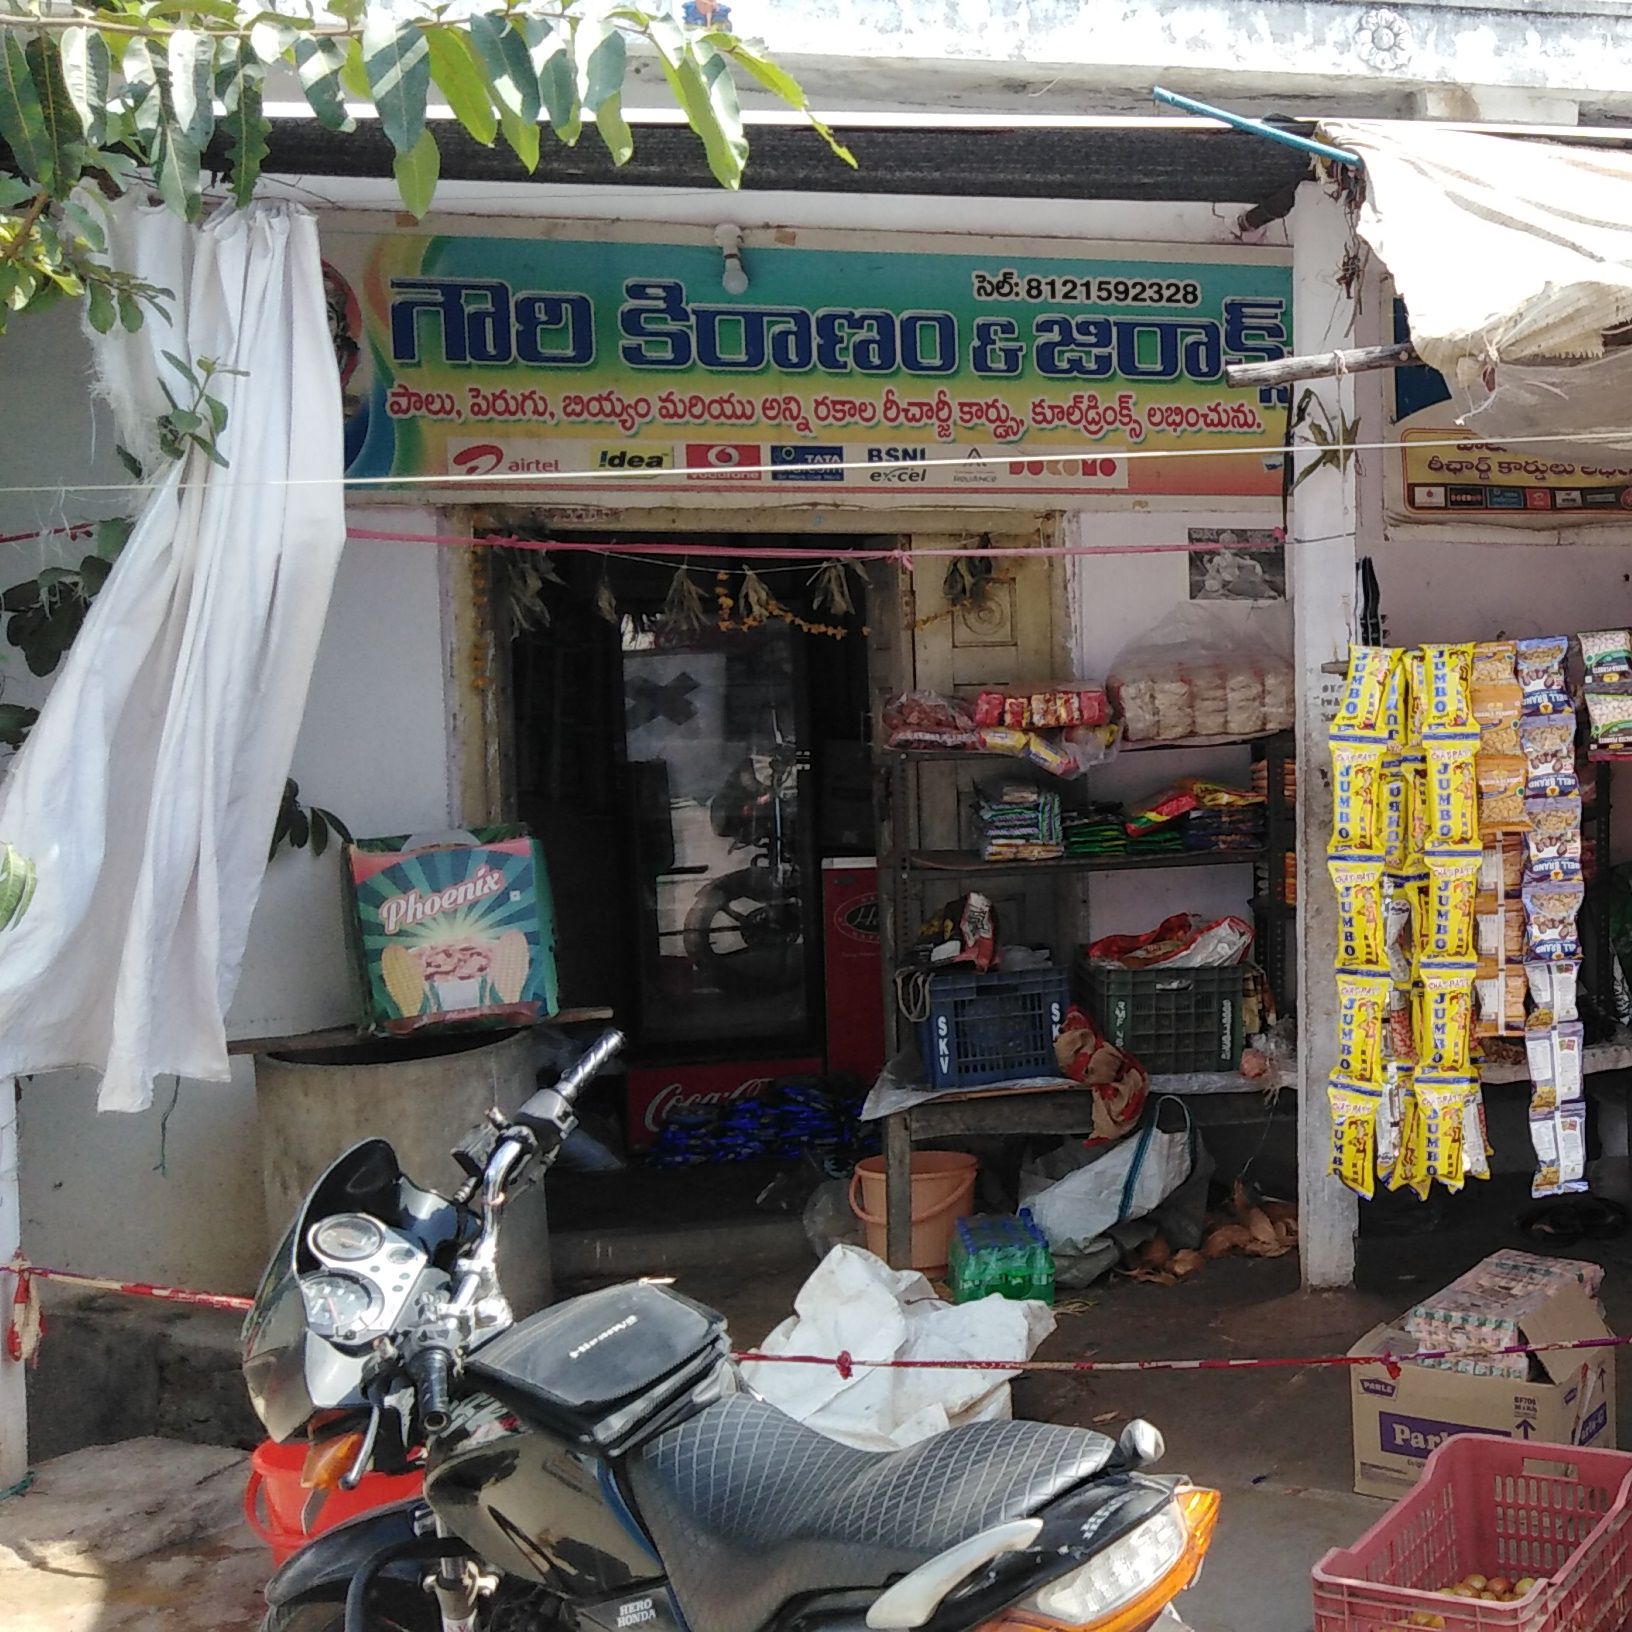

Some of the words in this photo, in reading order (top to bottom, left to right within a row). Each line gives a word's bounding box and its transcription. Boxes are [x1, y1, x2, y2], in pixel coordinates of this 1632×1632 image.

[1025, 278, 1199, 304] 8121592328
[390, 278, 594, 365] గౌరి
[619, 278, 958, 373] కిరాణం
[973, 317, 1023, 374] &
[389, 385, 462, 421] పాలు,
[469, 387, 555, 421] పెరుగు,
[562, 390, 651, 431] బియ్యం
[658, 393, 755, 423] మరియు
[761, 391, 813, 433] అన్ని
[815, 394, 876, 423] రకాల
[508, 457, 559, 473] airtel
[805, 454, 840, 464] TATA
[1434, 650, 1448, 714] JUMBO
[1338, 765, 1352, 839] JUMBO
[1439, 763, 1453, 837] JUMBO
[382, 869, 500, 931] Phoenix
[1341, 886, 1355, 956] JUMBO
[1435, 880, 1450, 950] JUMBO
[1340, 997, 1357, 1070] JUMBO
[1432, 993, 1446, 1063] JUMBO
[1426, 1108, 1440, 1176] JUMBO
[1363, 1382, 1393, 1393] PARLE
[617, 1609, 656, 1628] HONDA
[619, 1598, 652, 1616] HERO
